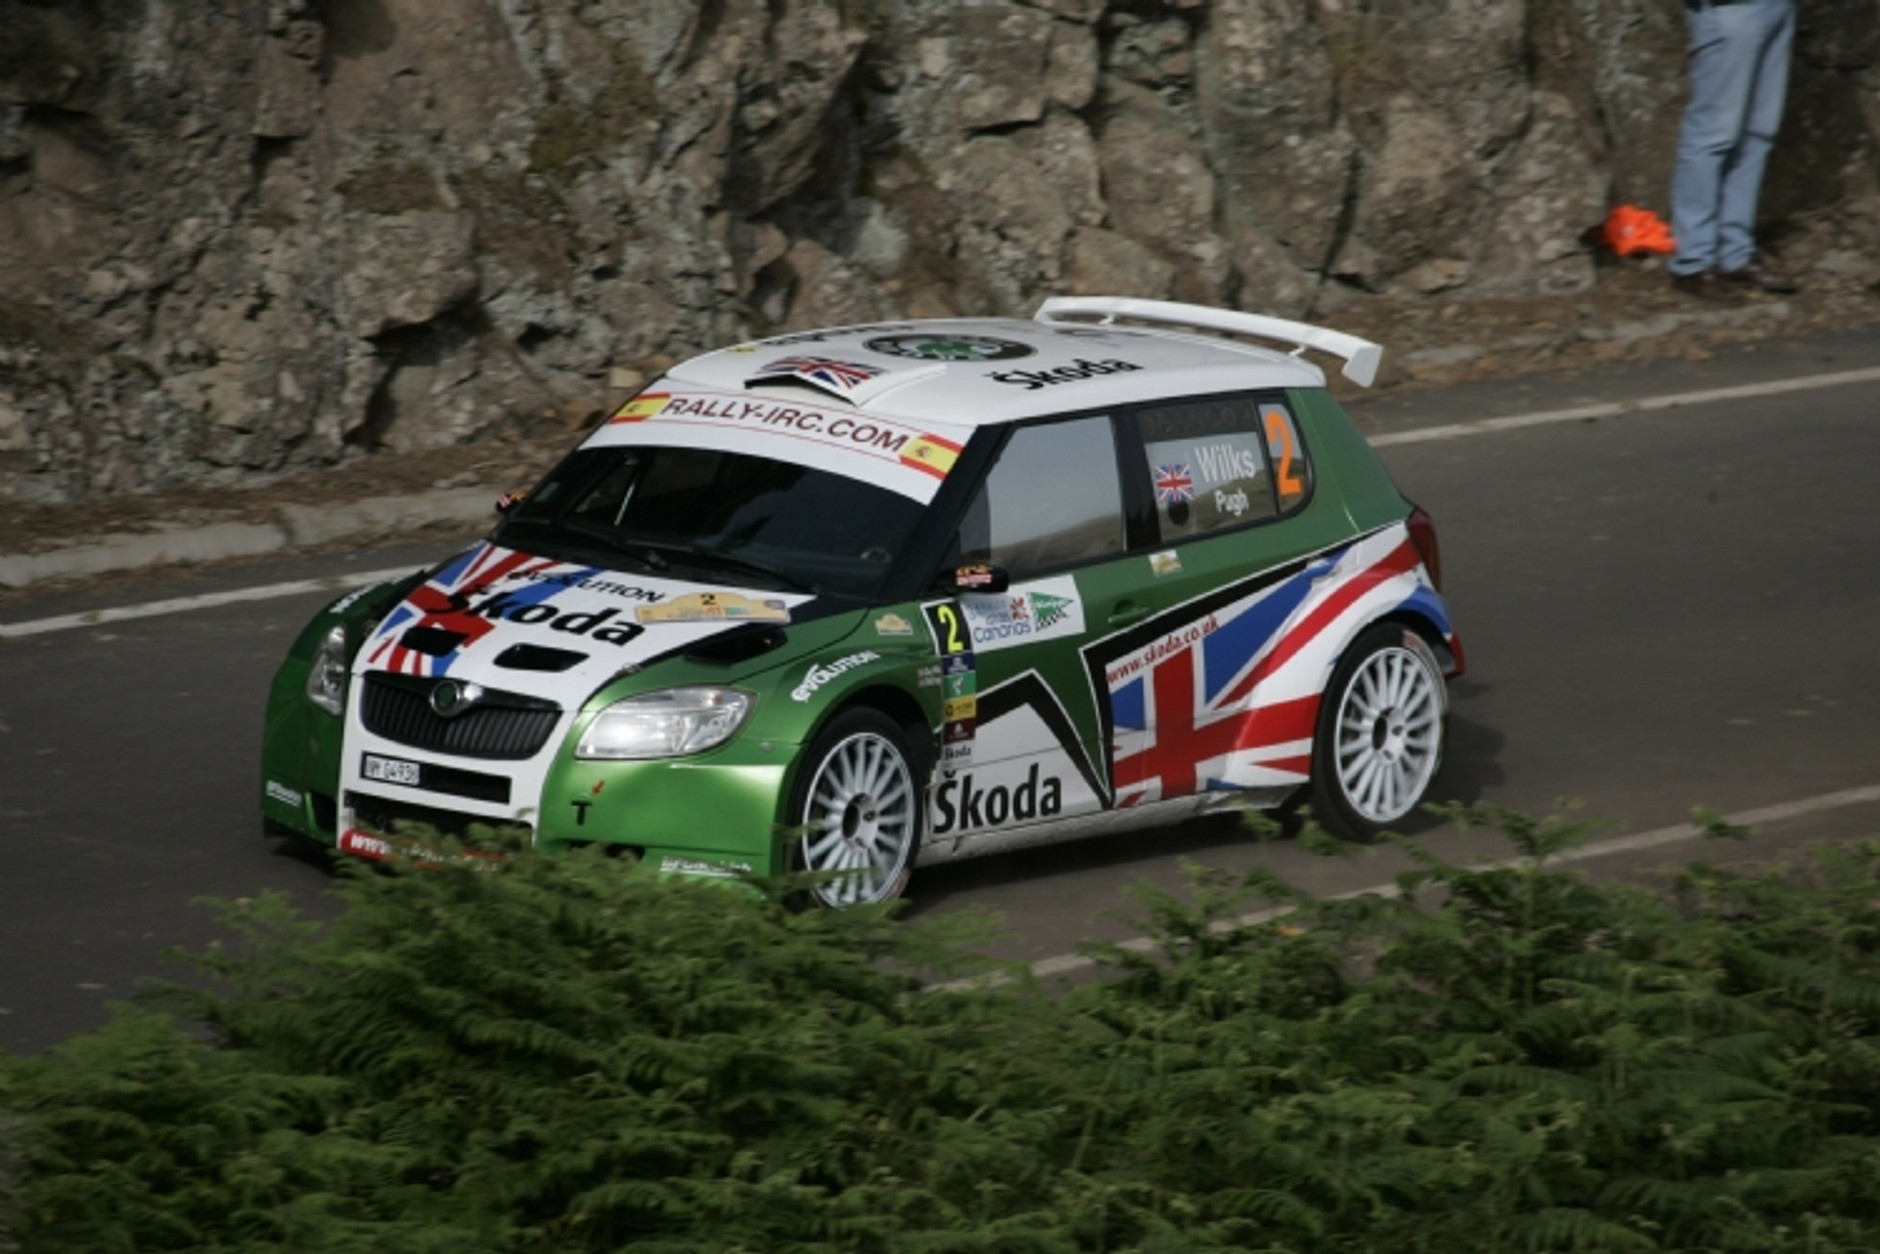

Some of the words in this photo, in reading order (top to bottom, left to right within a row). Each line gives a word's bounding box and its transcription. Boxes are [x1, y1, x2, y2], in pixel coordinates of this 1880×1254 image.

[660, 398, 909, 452] RALLY-IRC.COM
[1194, 444, 1255, 484] Wilks
[1265, 410, 1304, 496] 2
[1214, 489, 1249, 516] Pugh
[701, 593, 716, 606] 2
[937, 604, 964, 653] 2
[571, 801, 592, 826] T
[933, 763, 1062, 834] Škoda
